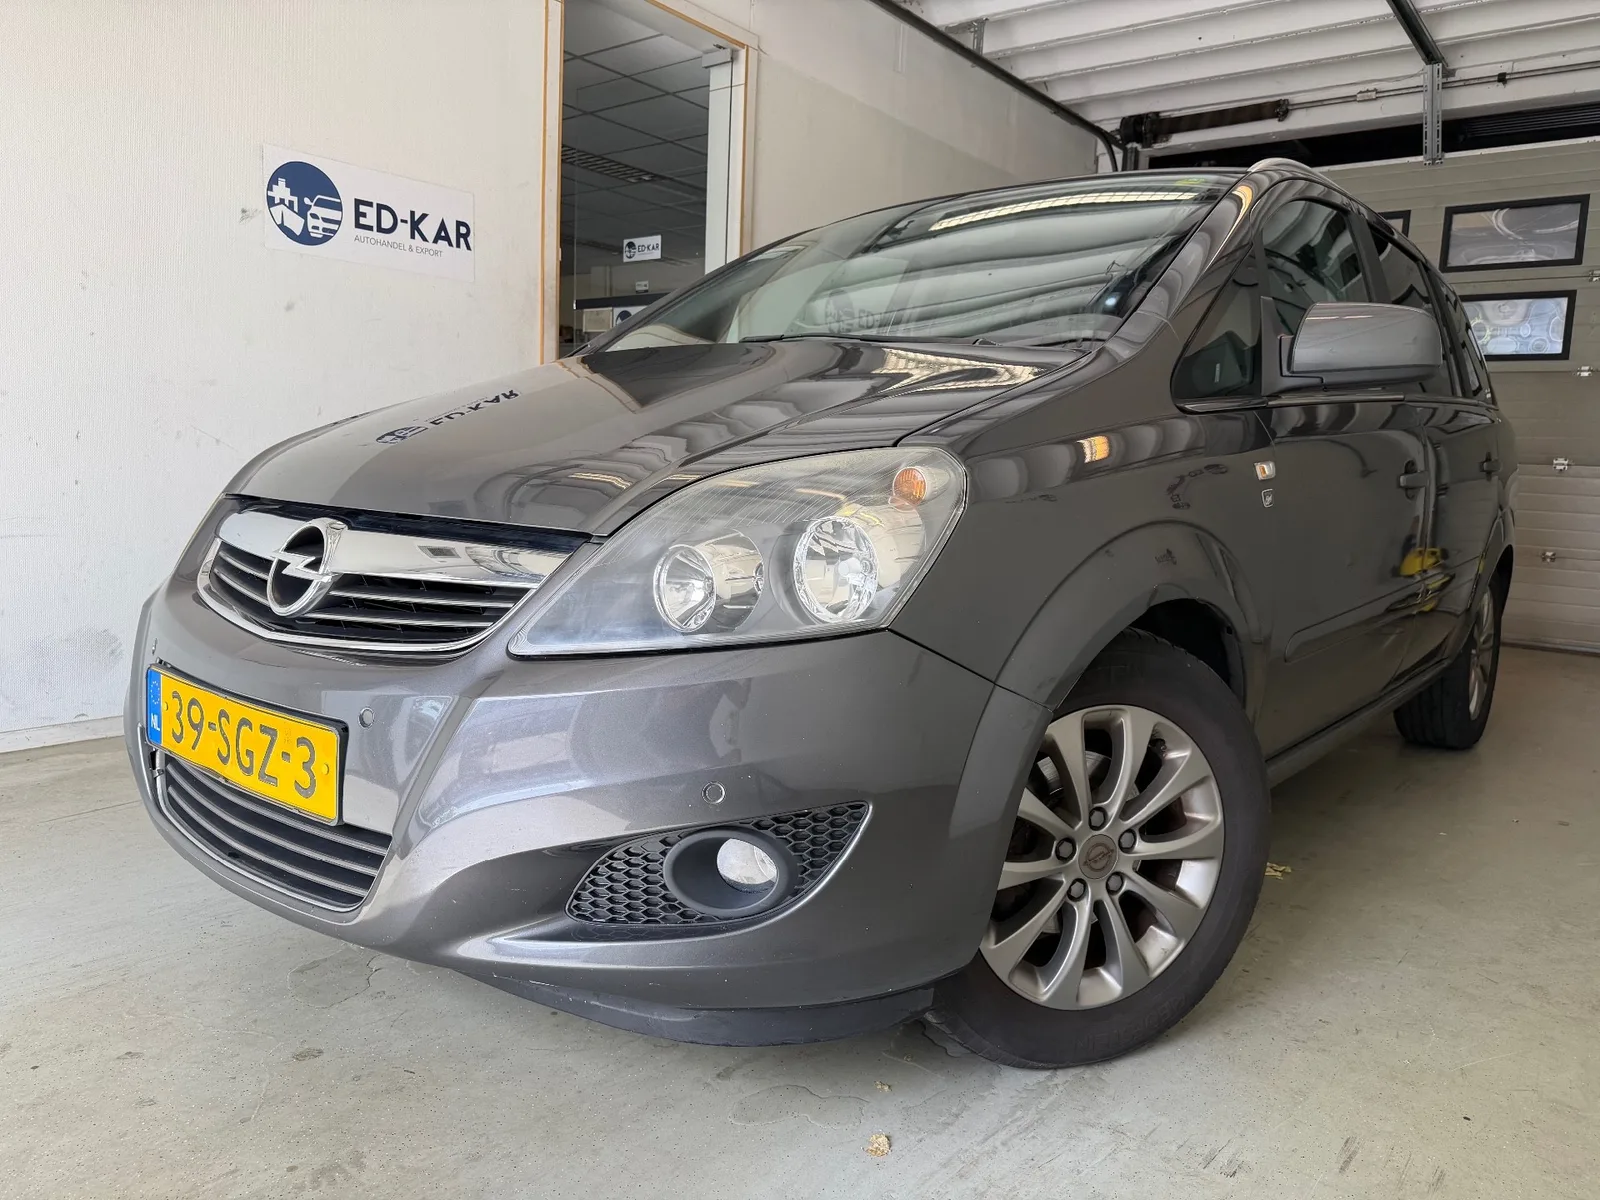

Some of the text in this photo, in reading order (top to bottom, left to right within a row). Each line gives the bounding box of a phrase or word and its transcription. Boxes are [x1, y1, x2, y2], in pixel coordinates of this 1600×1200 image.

[354, 198, 472, 251] ED-KAR
[354, 235, 444, 258] AUTOHANDEL & EXPORT
[150, 712, 161, 732] NL
[171, 690, 317, 799] 39-SGZ-3
